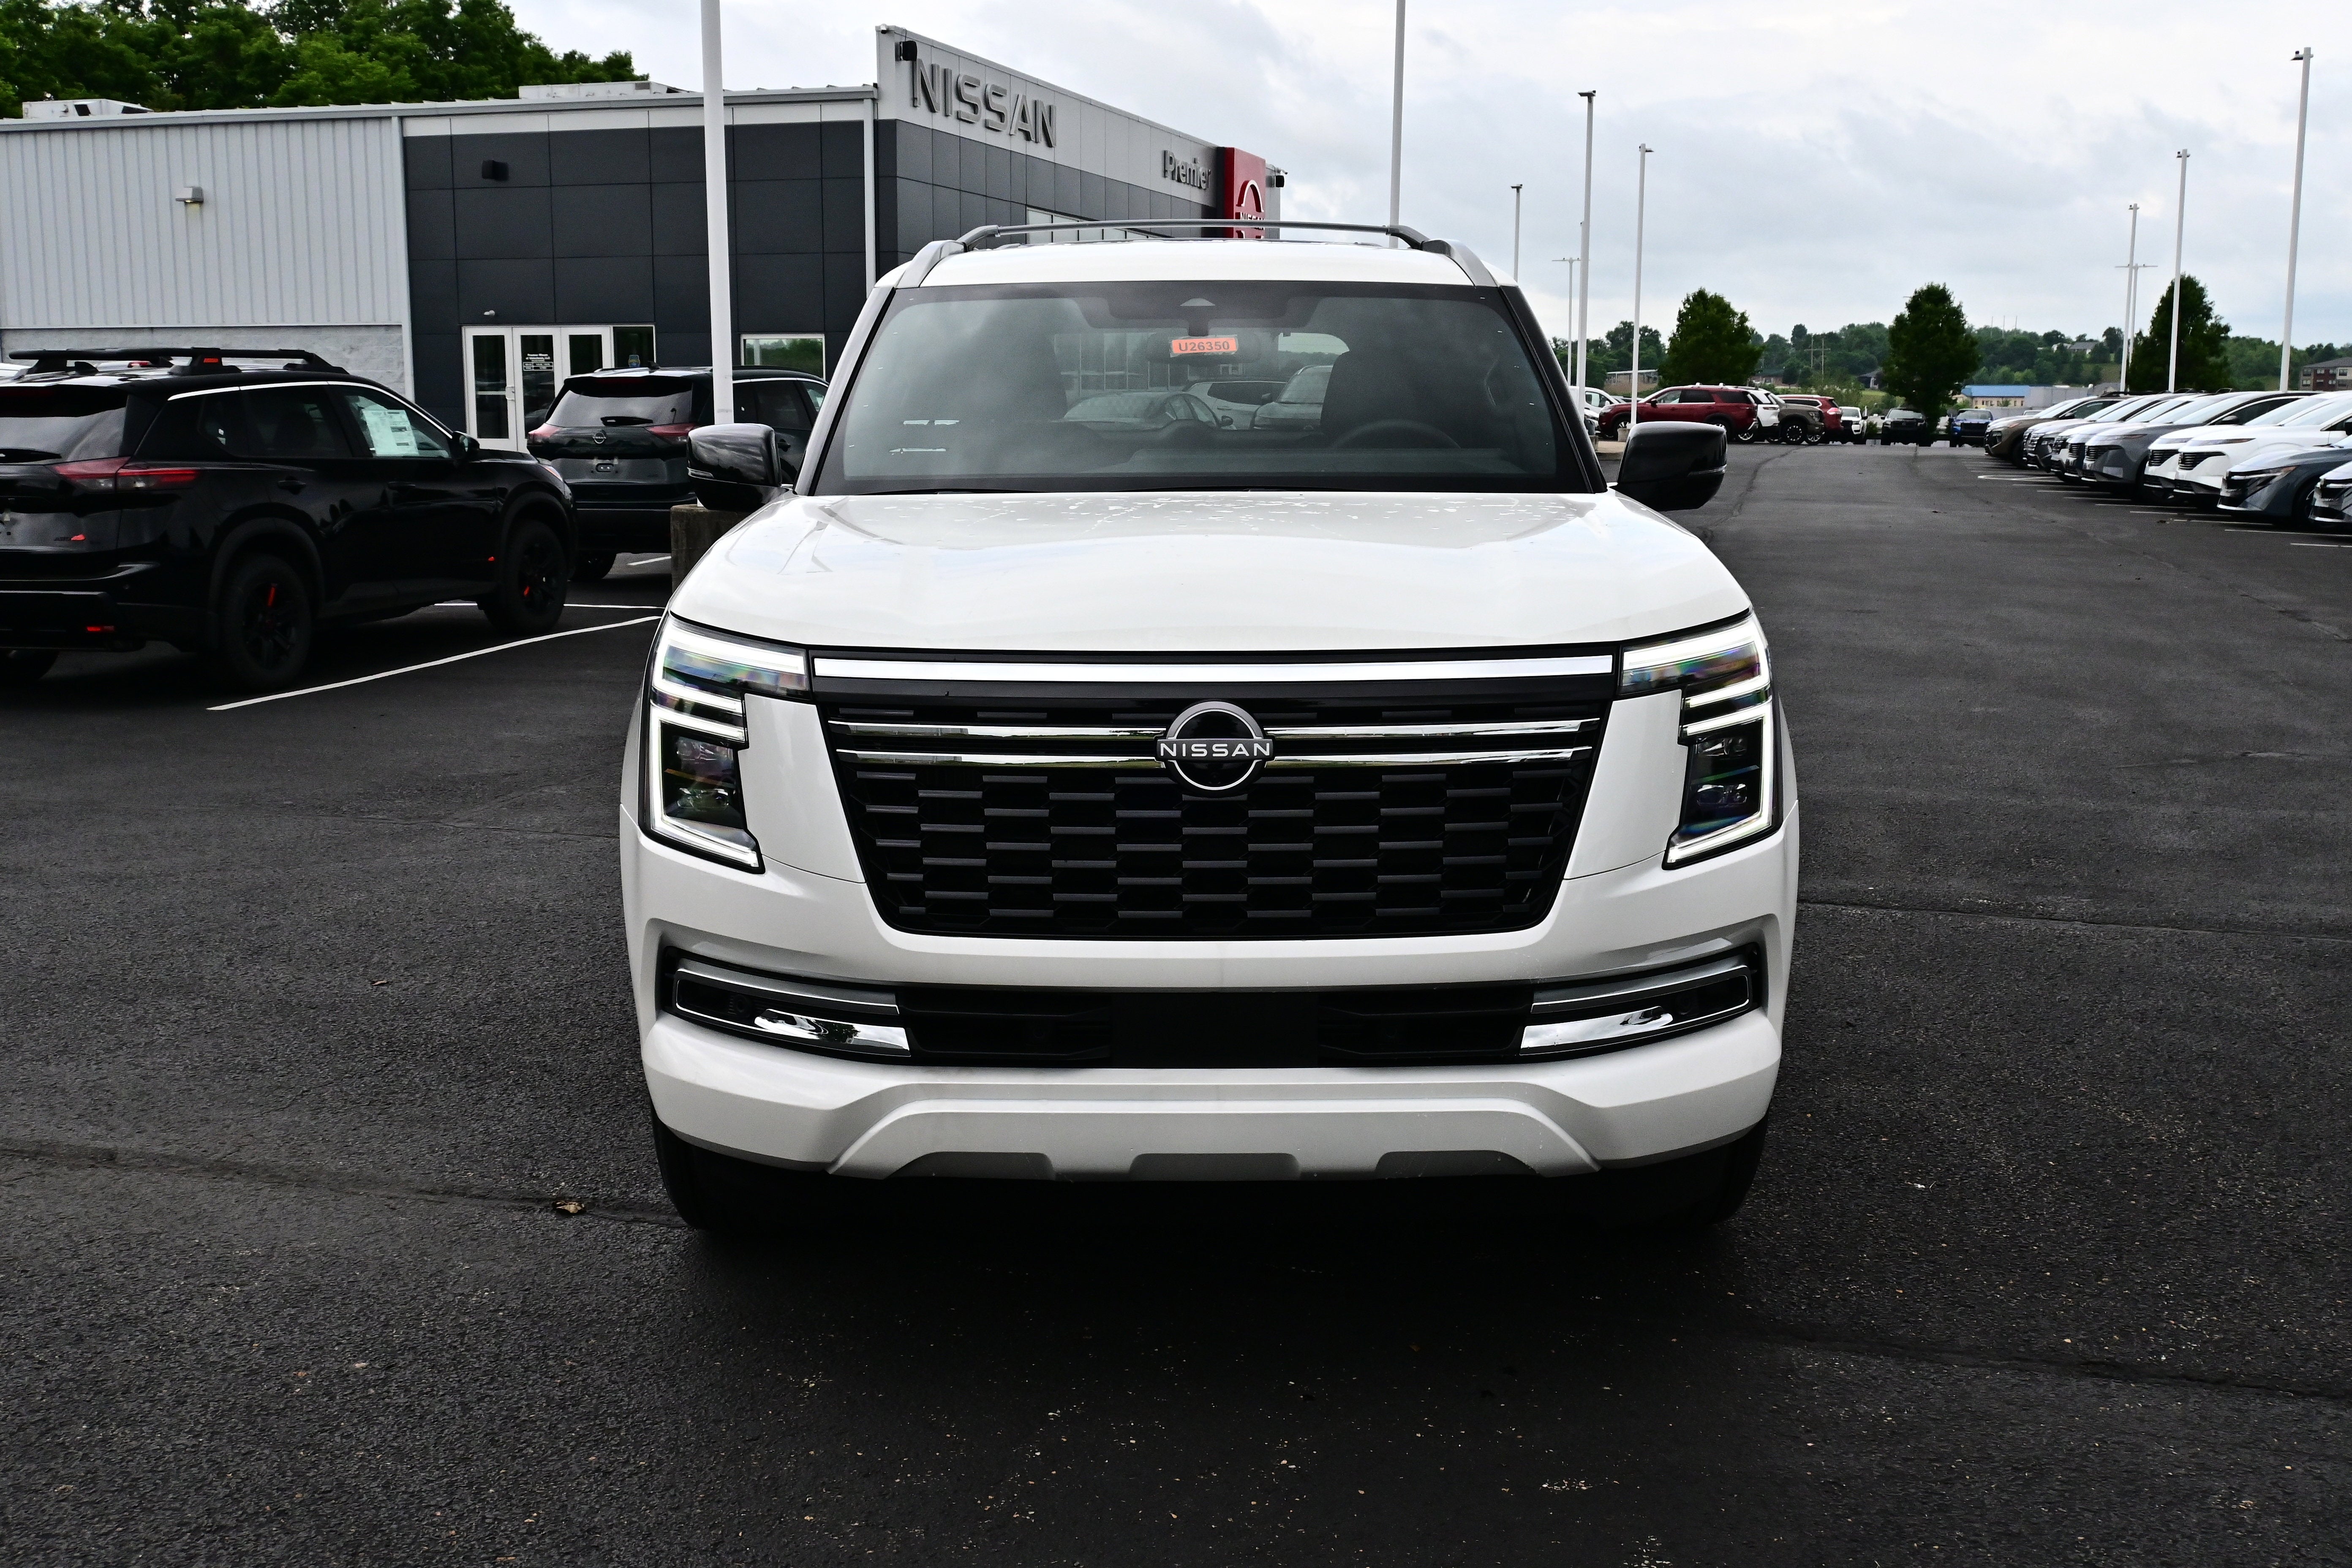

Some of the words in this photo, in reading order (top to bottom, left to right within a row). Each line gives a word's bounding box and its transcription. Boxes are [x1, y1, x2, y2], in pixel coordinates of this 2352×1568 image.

[912, 58, 1056, 147] NISSAN
[1163, 150, 1211, 190] Premier
[1179, 341, 1230, 351] U26350
[1160, 743, 1270, 757] NISSAN
